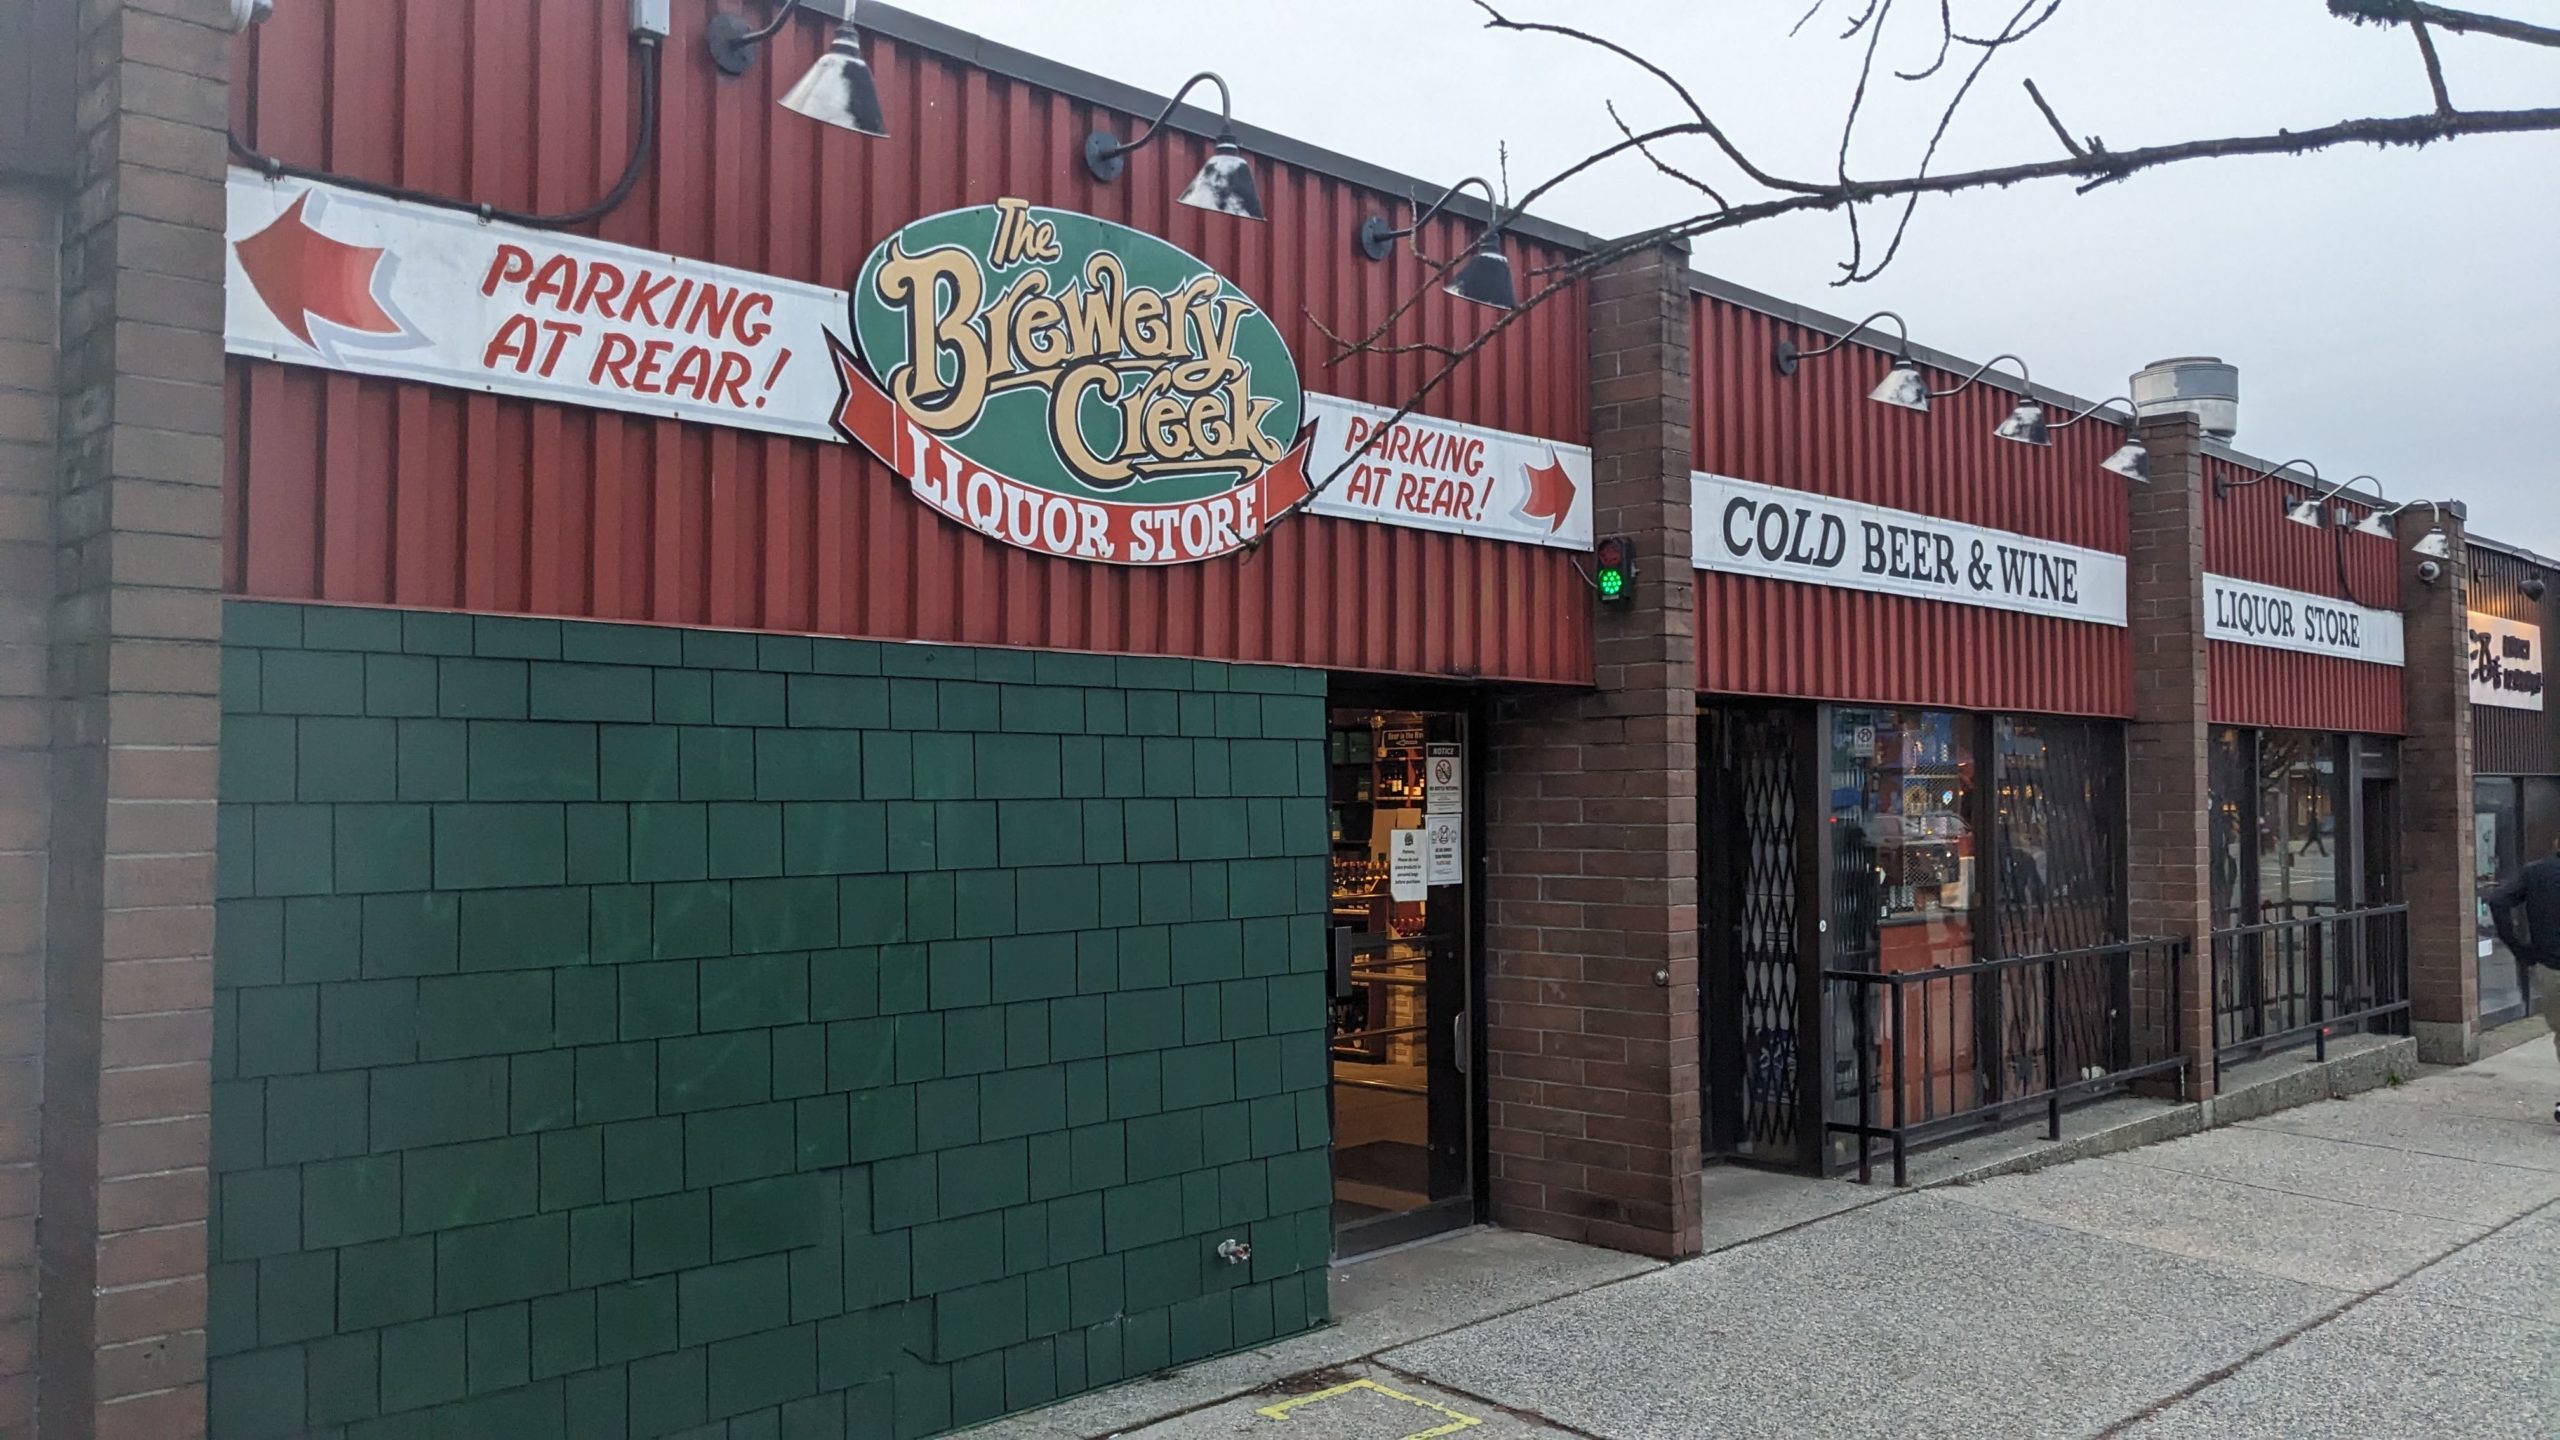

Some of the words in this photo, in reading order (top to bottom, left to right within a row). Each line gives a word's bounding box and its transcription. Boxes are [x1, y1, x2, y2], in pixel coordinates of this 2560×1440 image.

[991, 197, 1060, 268] The
[481, 243, 774, 348] PARKING
[877, 241, 1257, 433] Brewery
[482, 313, 582, 380] AT
[588, 331, 794, 410] REAR!
[1053, 363, 1283, 486] Creek
[1344, 415, 1484, 477] PARKING
[907, 421, 1115, 559] LIQUOR
[1129, 488, 1258, 563] STORE
[1346, 463, 1392, 506] AT
[1395, 473, 1495, 522] REAR!
[1722, 496, 1847, 569] COLD
[1860, 520, 1959, 585] BEER
[1967, 539, 1994, 591] &
[1996, 545, 2079, 604] WINE
[2215, 588, 2295, 637] LIQUOR
[2304, 604, 2361, 648] STORE
[1432, 746, 1455, 756] NOTICE
